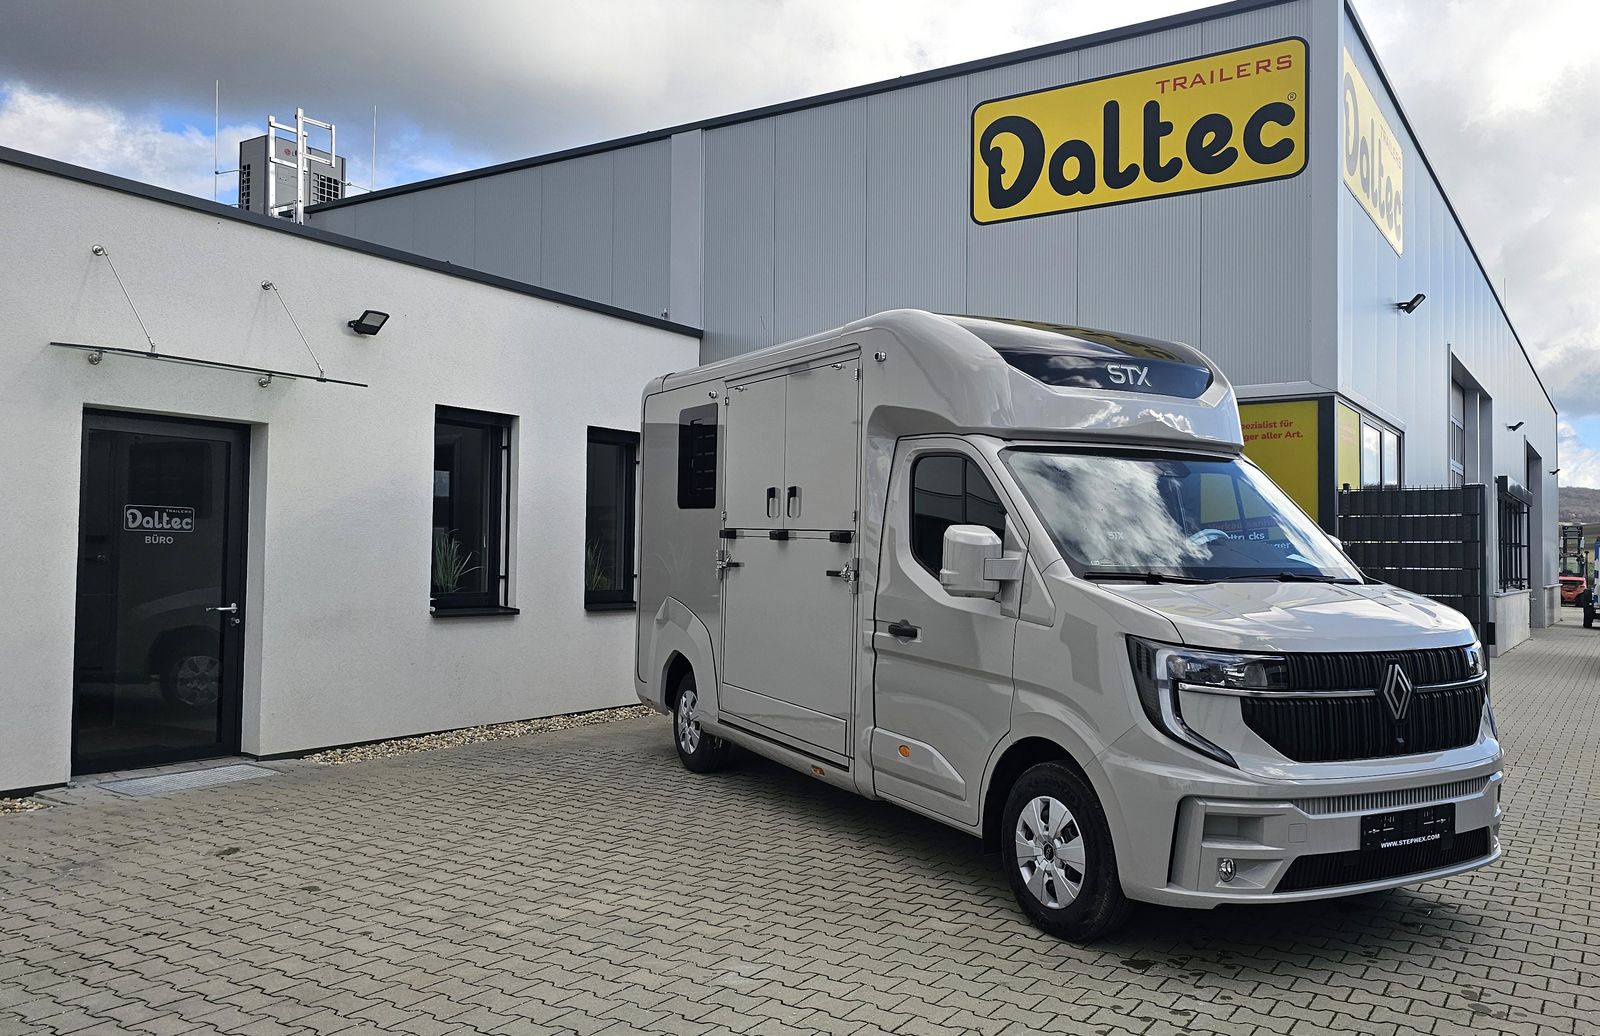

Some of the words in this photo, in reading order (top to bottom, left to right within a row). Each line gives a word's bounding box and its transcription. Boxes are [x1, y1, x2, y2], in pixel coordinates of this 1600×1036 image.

[1155, 54, 1293, 94] TRAILERS
[979, 99, 1296, 210] Daltec
[1344, 71, 1401, 241] Daltec
[1106, 362, 1153, 387] STX
[1241, 420, 1277, 430] pezialist
[1280, 420, 1293, 428] für
[1243, 433, 1259, 442] ger
[1261, 431, 1282, 440] aller
[1285, 430, 1304, 439] Art.
[126, 508, 192, 530] Daltec
[145, 534, 174, 544] BÜRO
[1380, 833, 1441, 849] WWW.STEPHEX.COM
